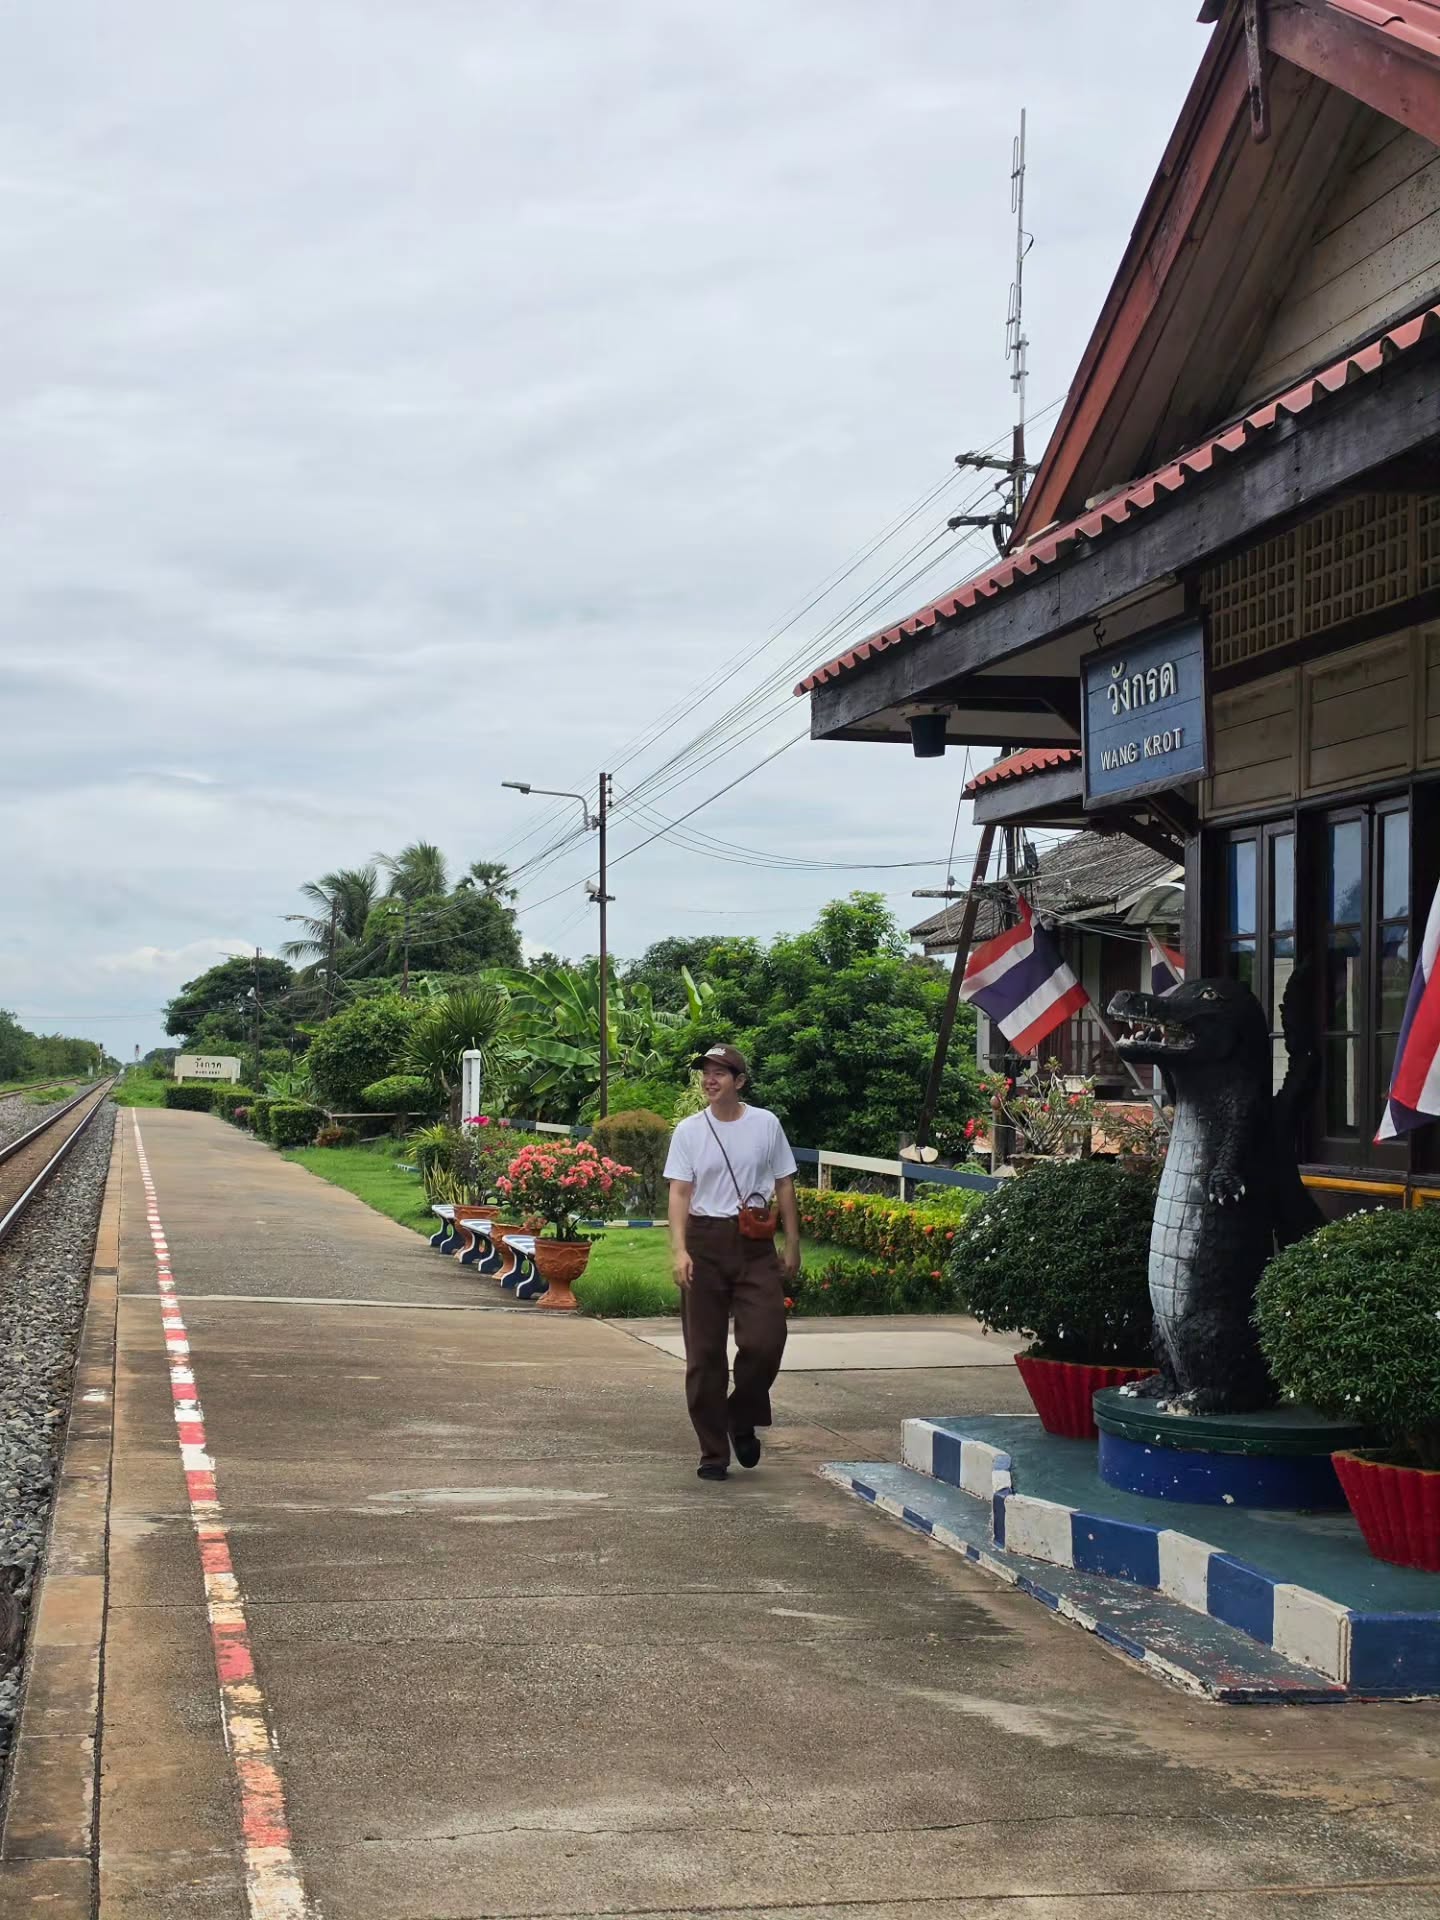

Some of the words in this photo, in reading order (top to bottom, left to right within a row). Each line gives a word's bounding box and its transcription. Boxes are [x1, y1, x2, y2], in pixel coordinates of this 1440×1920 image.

[1107, 661, 1176, 715] วังกรด
[1100, 742, 1138, 771] WANG
[1143, 727, 1182, 758] KROT
